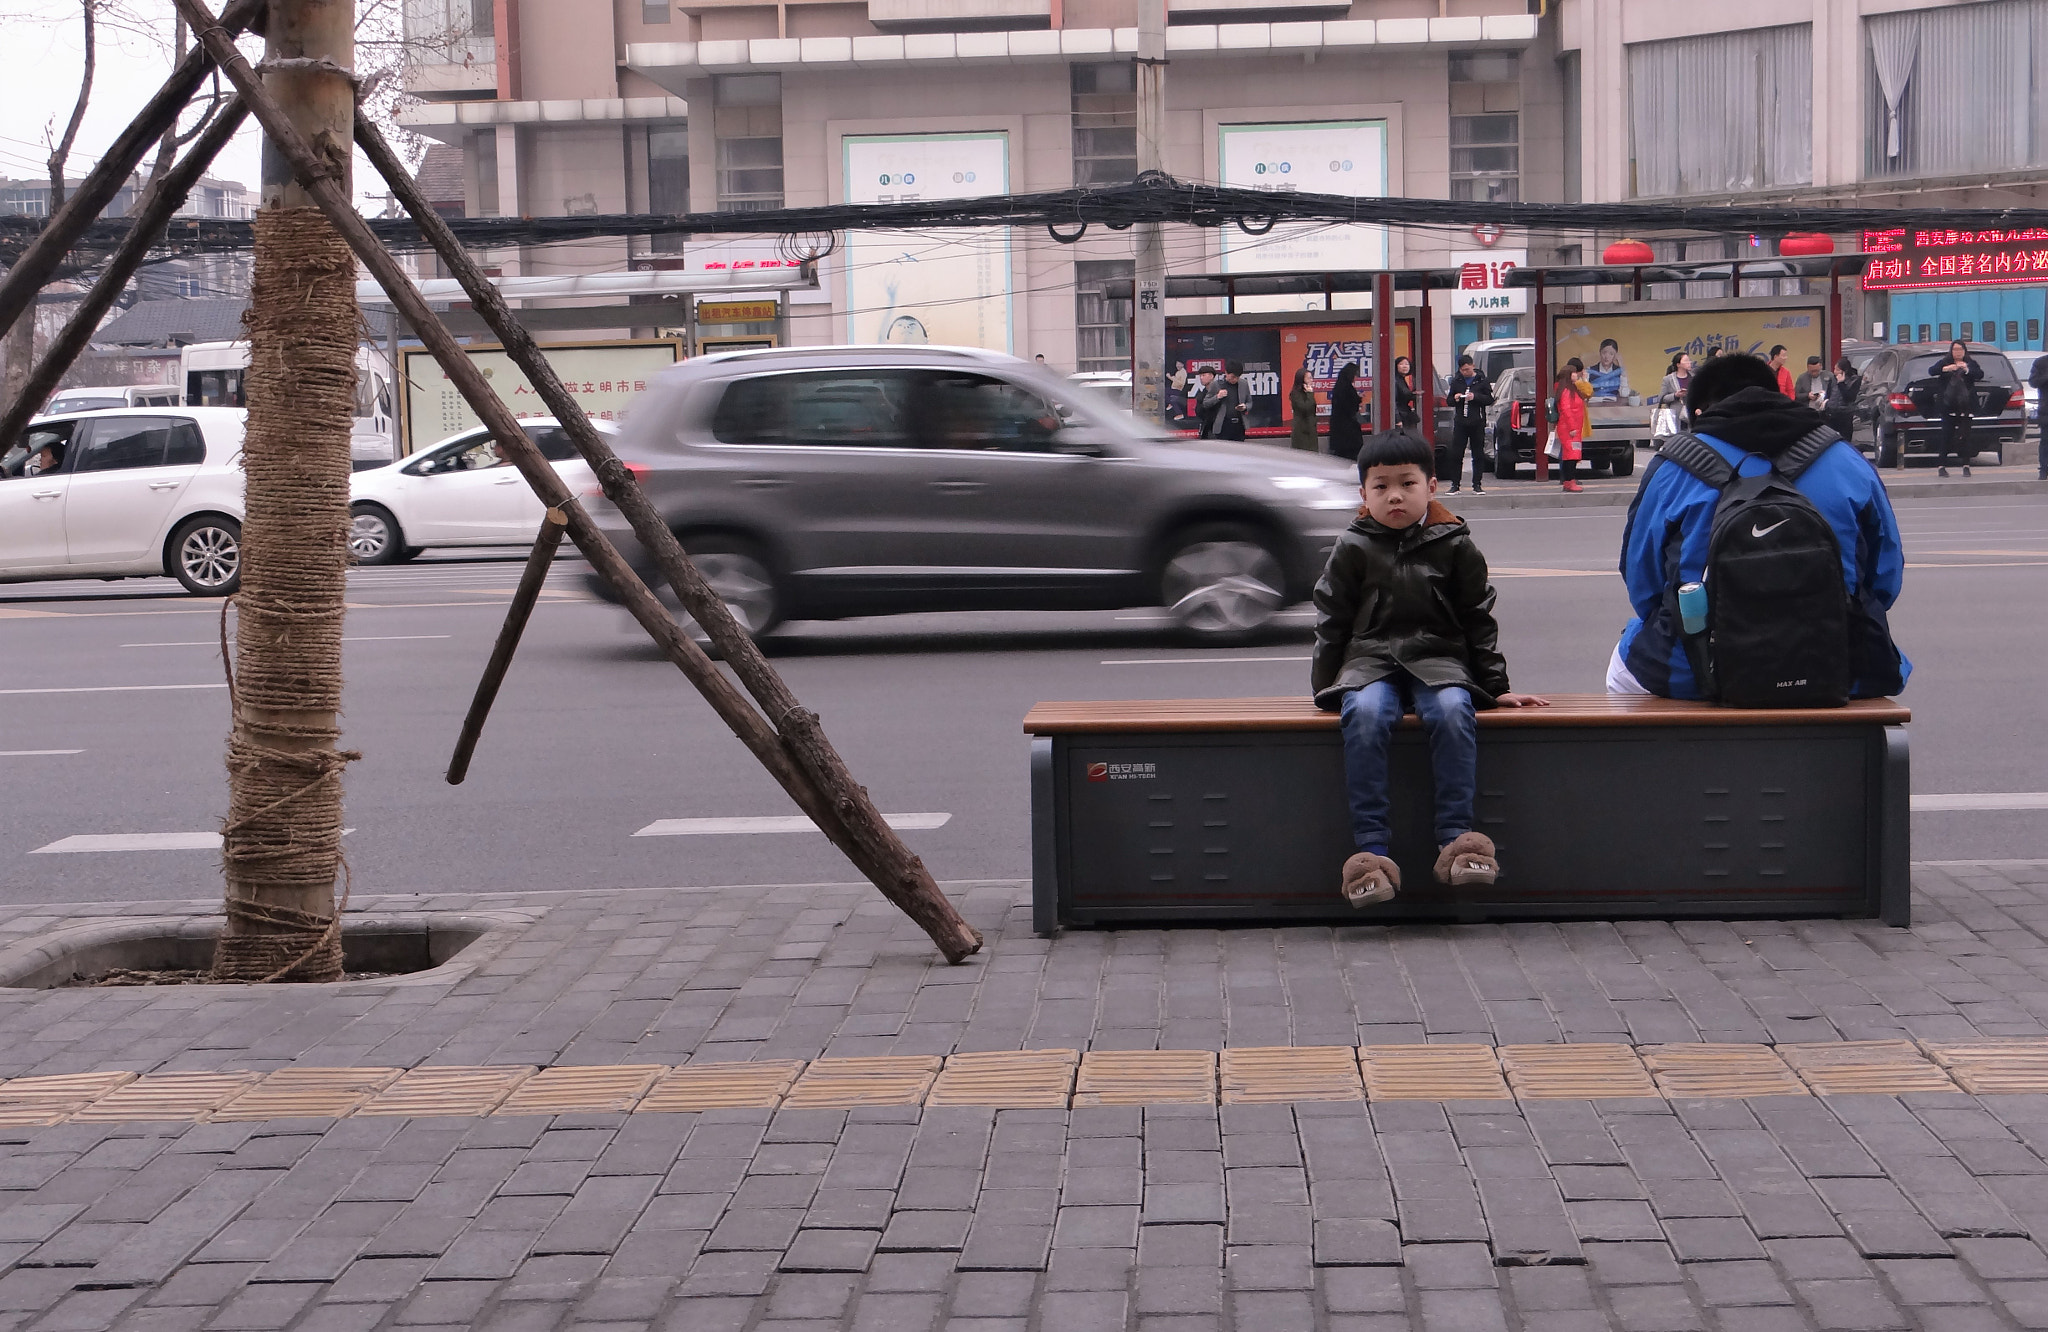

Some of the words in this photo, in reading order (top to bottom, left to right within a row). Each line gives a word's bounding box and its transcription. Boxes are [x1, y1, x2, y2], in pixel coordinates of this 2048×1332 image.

[1469, 296, 1510, 309] 小儿内科
[701, 306, 772, 319] 出租汽车停靠站
[514, 379, 647, 395] 人做文明市民
[1108, 763, 1156, 774] 西安高新
